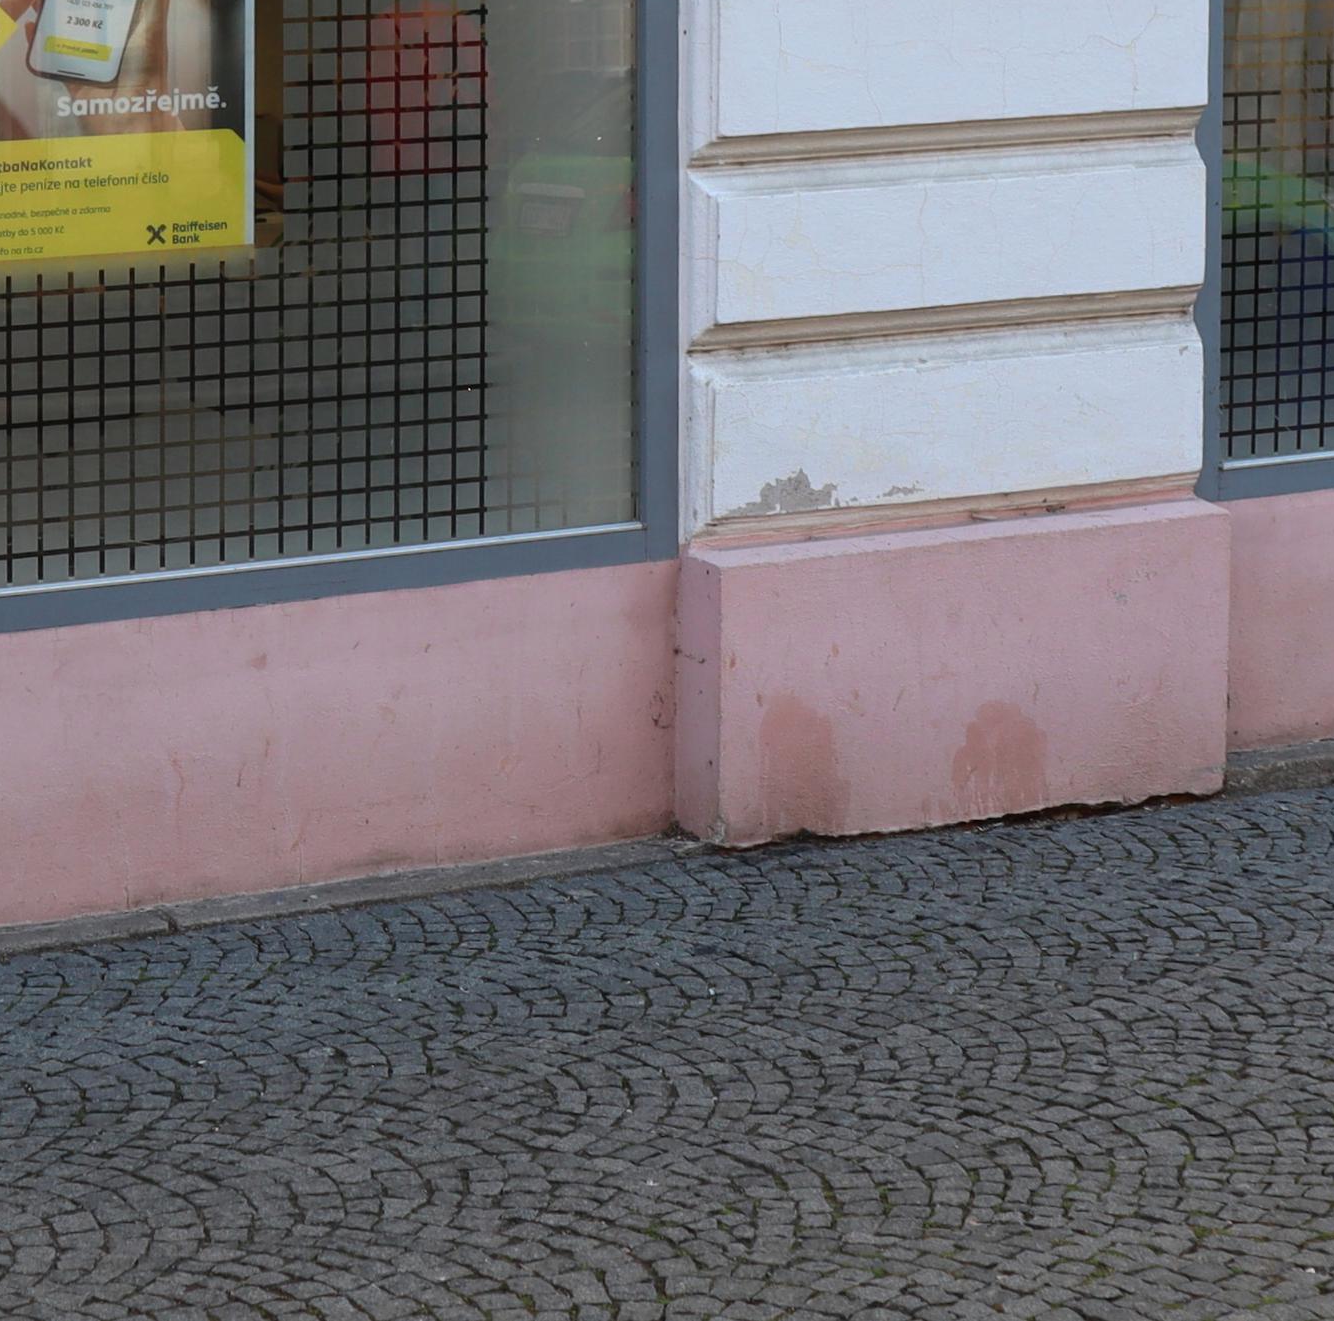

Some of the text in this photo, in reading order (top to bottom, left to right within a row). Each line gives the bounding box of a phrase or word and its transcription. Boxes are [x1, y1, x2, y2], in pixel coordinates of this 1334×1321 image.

[66, 15, 73, 25] 2
[74, 17, 90, 27] 300
[56, 85, 228, 118] Samozřejmě.
[20, 179, 61, 195] peníze
[64, 179, 81, 189] na
[83, 173, 139, 189] telefonní
[141, 171, 170, 185] číslo
[18, 227, 29, 237] do
[171, 218, 228, 234] Raiffeisen
[172, 232, 201, 245] Bank
